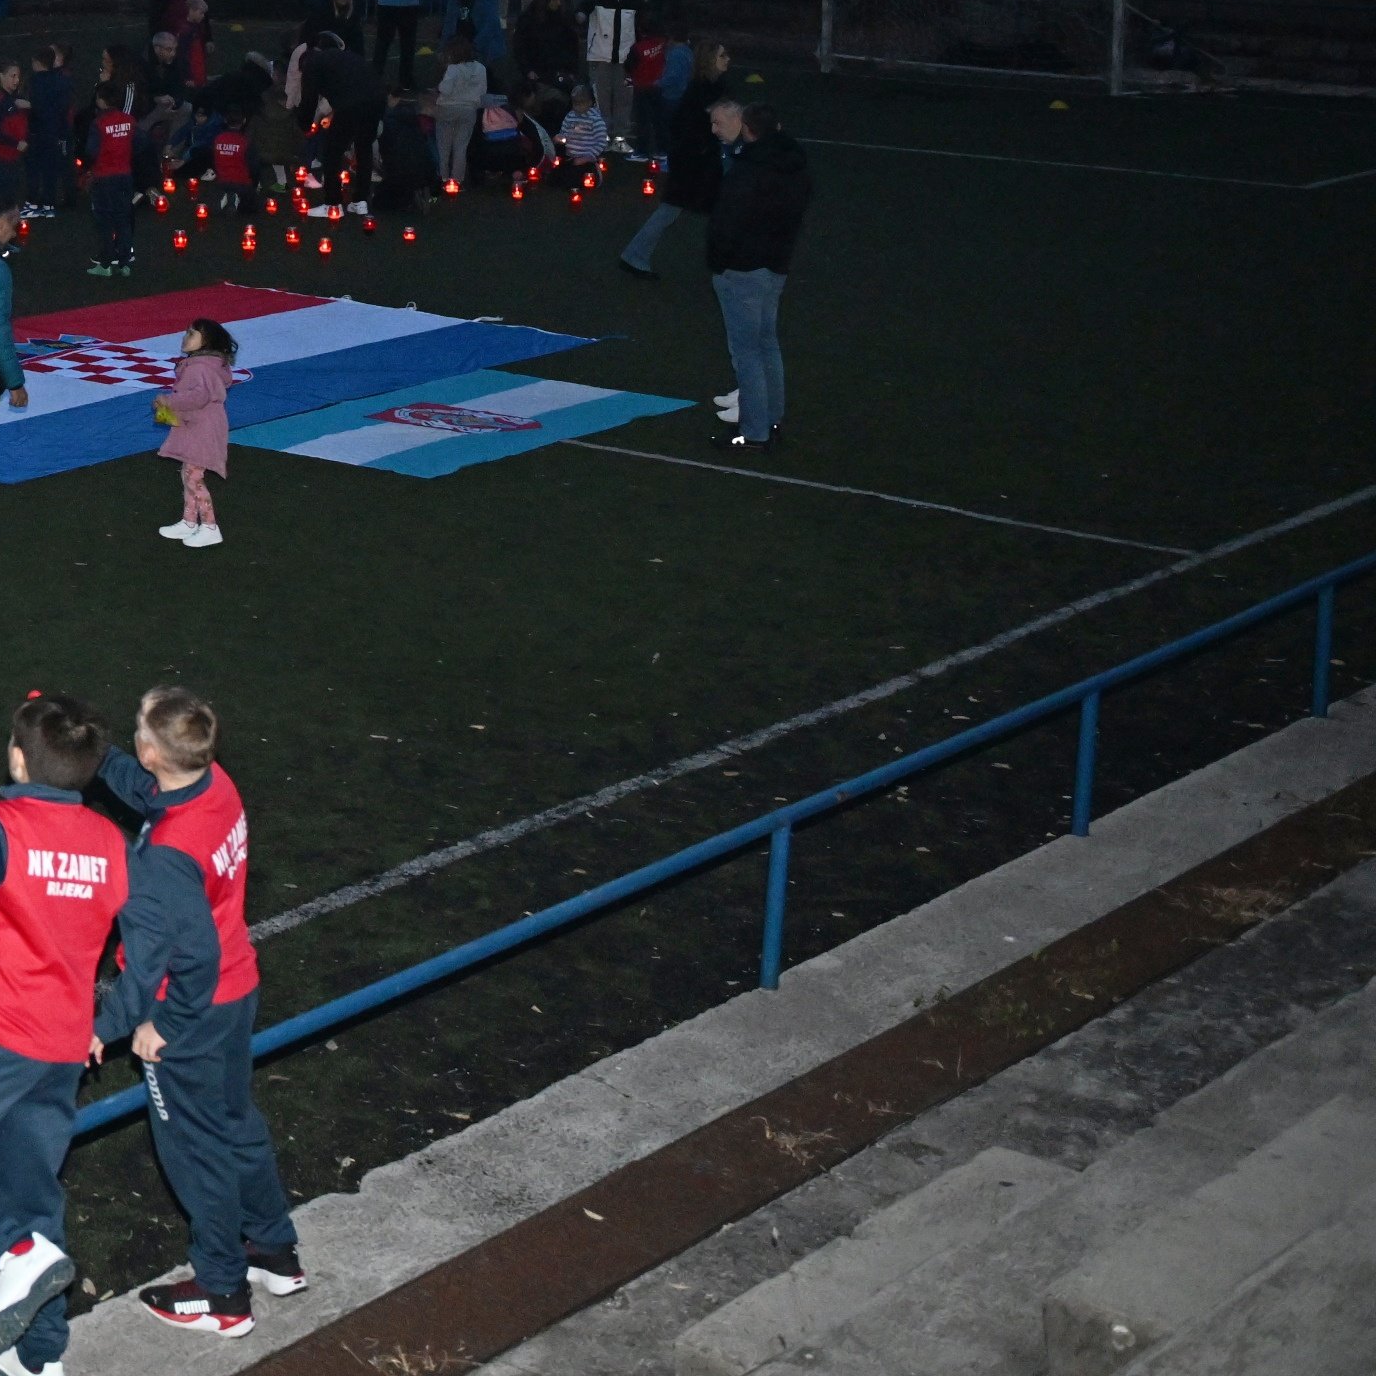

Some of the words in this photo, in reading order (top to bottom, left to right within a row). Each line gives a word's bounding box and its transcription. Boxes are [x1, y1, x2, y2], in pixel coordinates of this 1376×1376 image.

[27, 848, 55, 878] NK
[56, 851, 109, 885] ZAMET
[46, 880, 94, 900] RIJEKA
[174, 1299, 211, 1315] PUMA
